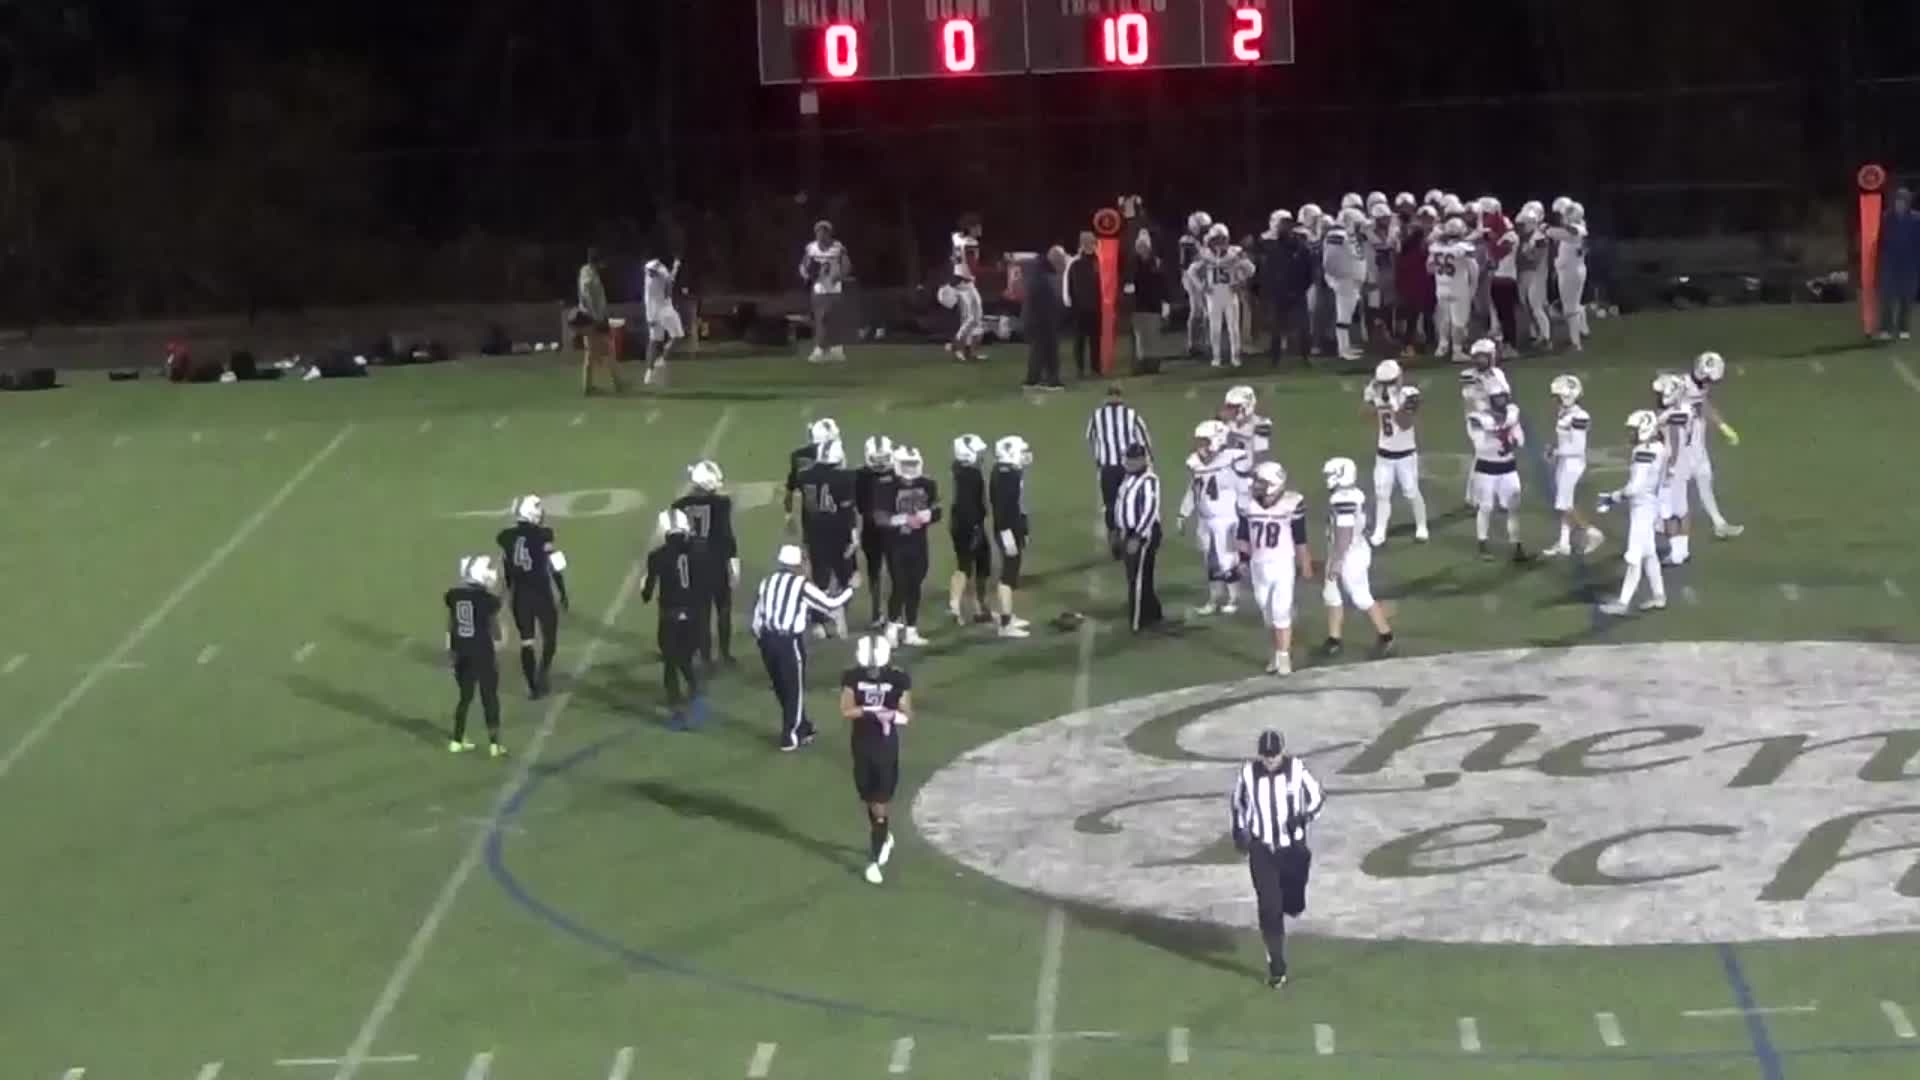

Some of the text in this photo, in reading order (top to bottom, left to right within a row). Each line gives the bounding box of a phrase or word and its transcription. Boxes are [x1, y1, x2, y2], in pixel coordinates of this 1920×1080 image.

[825, 25, 858, 77] 0
[943, 20, 975, 71] 0
[1102, 13, 1149, 65] 10
[1233, 9, 1263, 61] 2
[1382, 412, 1393, 438] 6
[1250, 520, 1281, 549] 78
[513, 536, 532, 571] 4
[677, 553, 690, 589] 1
[455, 600, 475, 637] 9
